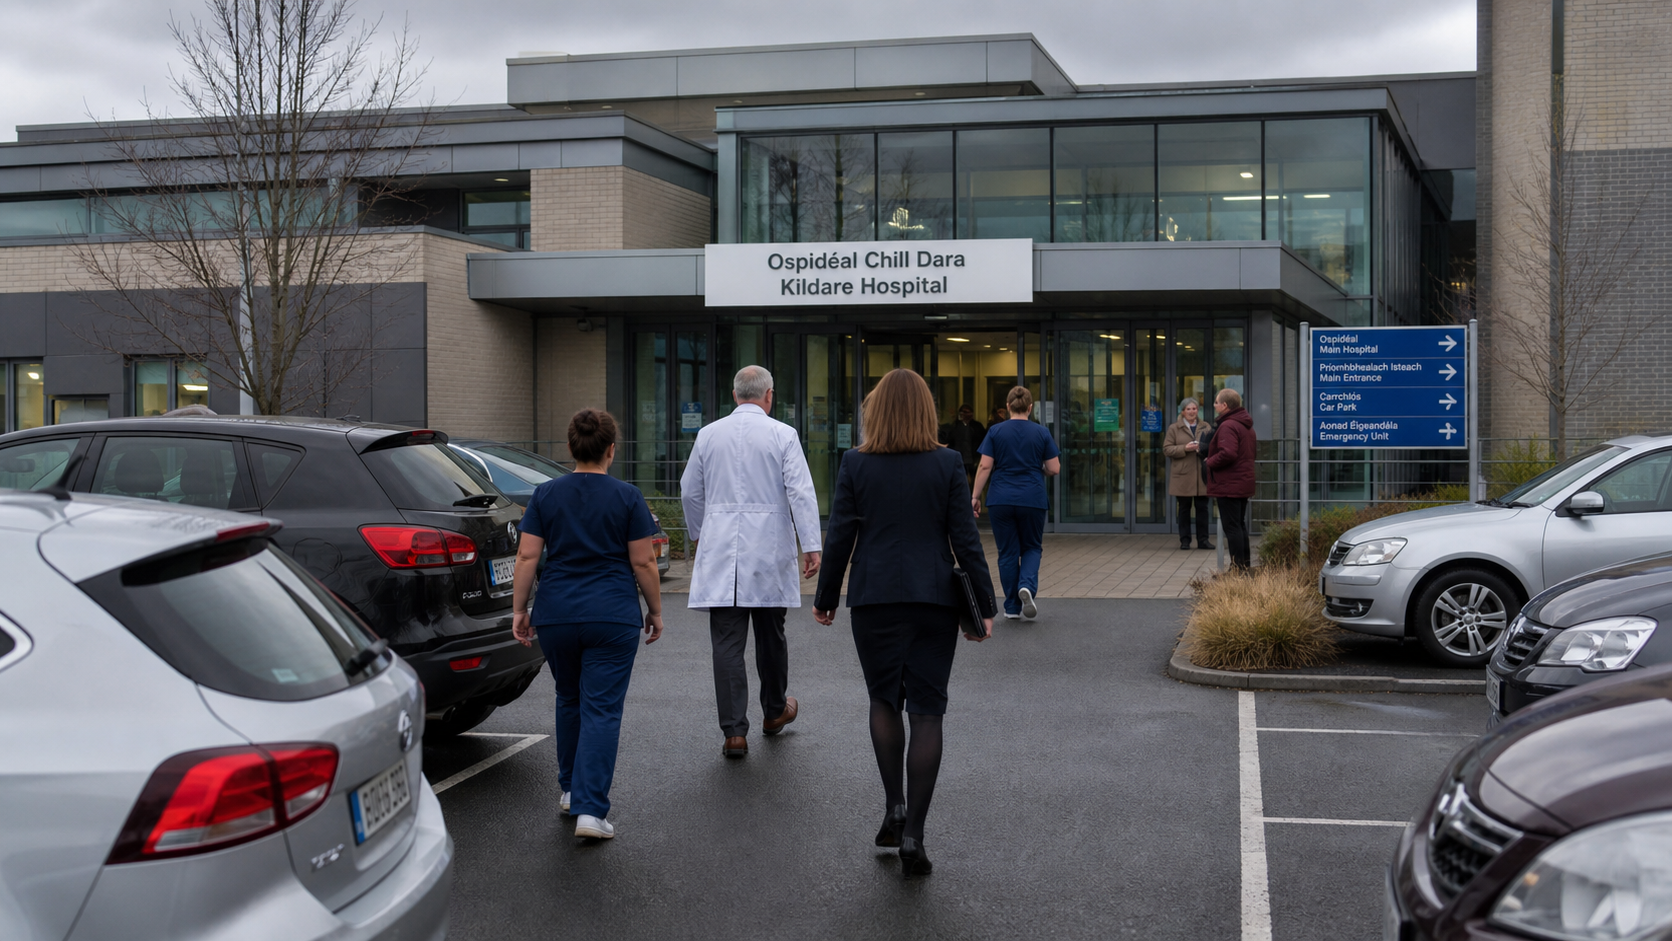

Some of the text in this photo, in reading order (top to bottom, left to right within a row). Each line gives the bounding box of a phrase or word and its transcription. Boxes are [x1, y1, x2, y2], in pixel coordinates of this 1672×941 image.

[767, 250, 965, 274] Ospidéal Chill Dara
[780, 276, 948, 298] Kildare Hospital
[1319, 345, 1379, 355] Main Hospital
[1390, 362, 1422, 371] Isteach
[1319, 373, 1382, 382] Main Entrance
[1319, 403, 1357, 412] Car Park
[1319, 421, 1348, 430] Aonad
[1319, 432, 1389, 442] Emergency Unit
